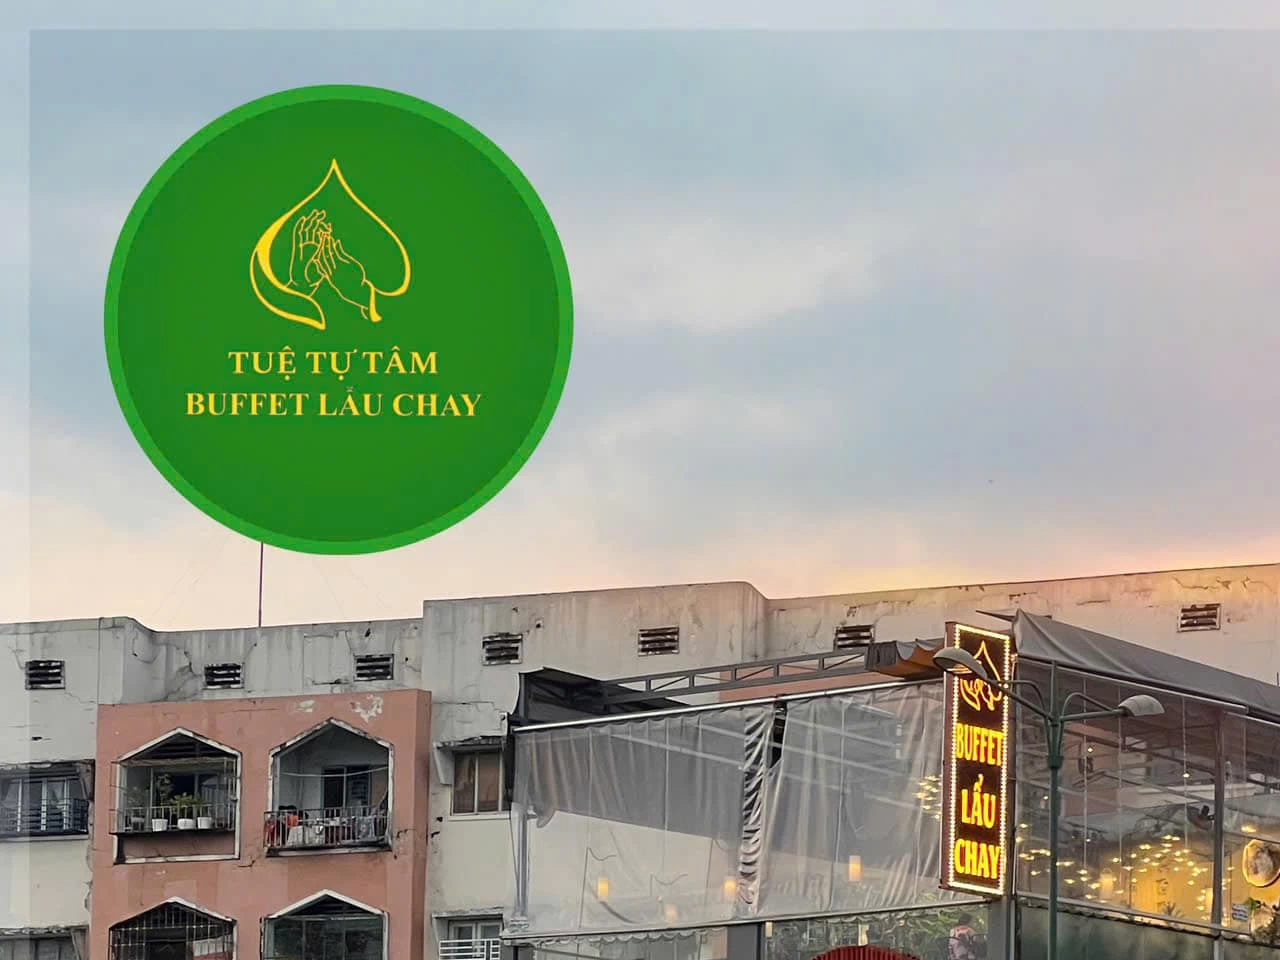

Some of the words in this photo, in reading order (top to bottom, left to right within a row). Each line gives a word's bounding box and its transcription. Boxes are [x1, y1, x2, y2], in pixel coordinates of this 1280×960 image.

[956, 723, 1004, 767] BUFFET
[961, 773, 997, 829] LẨU
[955, 838, 1000, 879] CHAY
